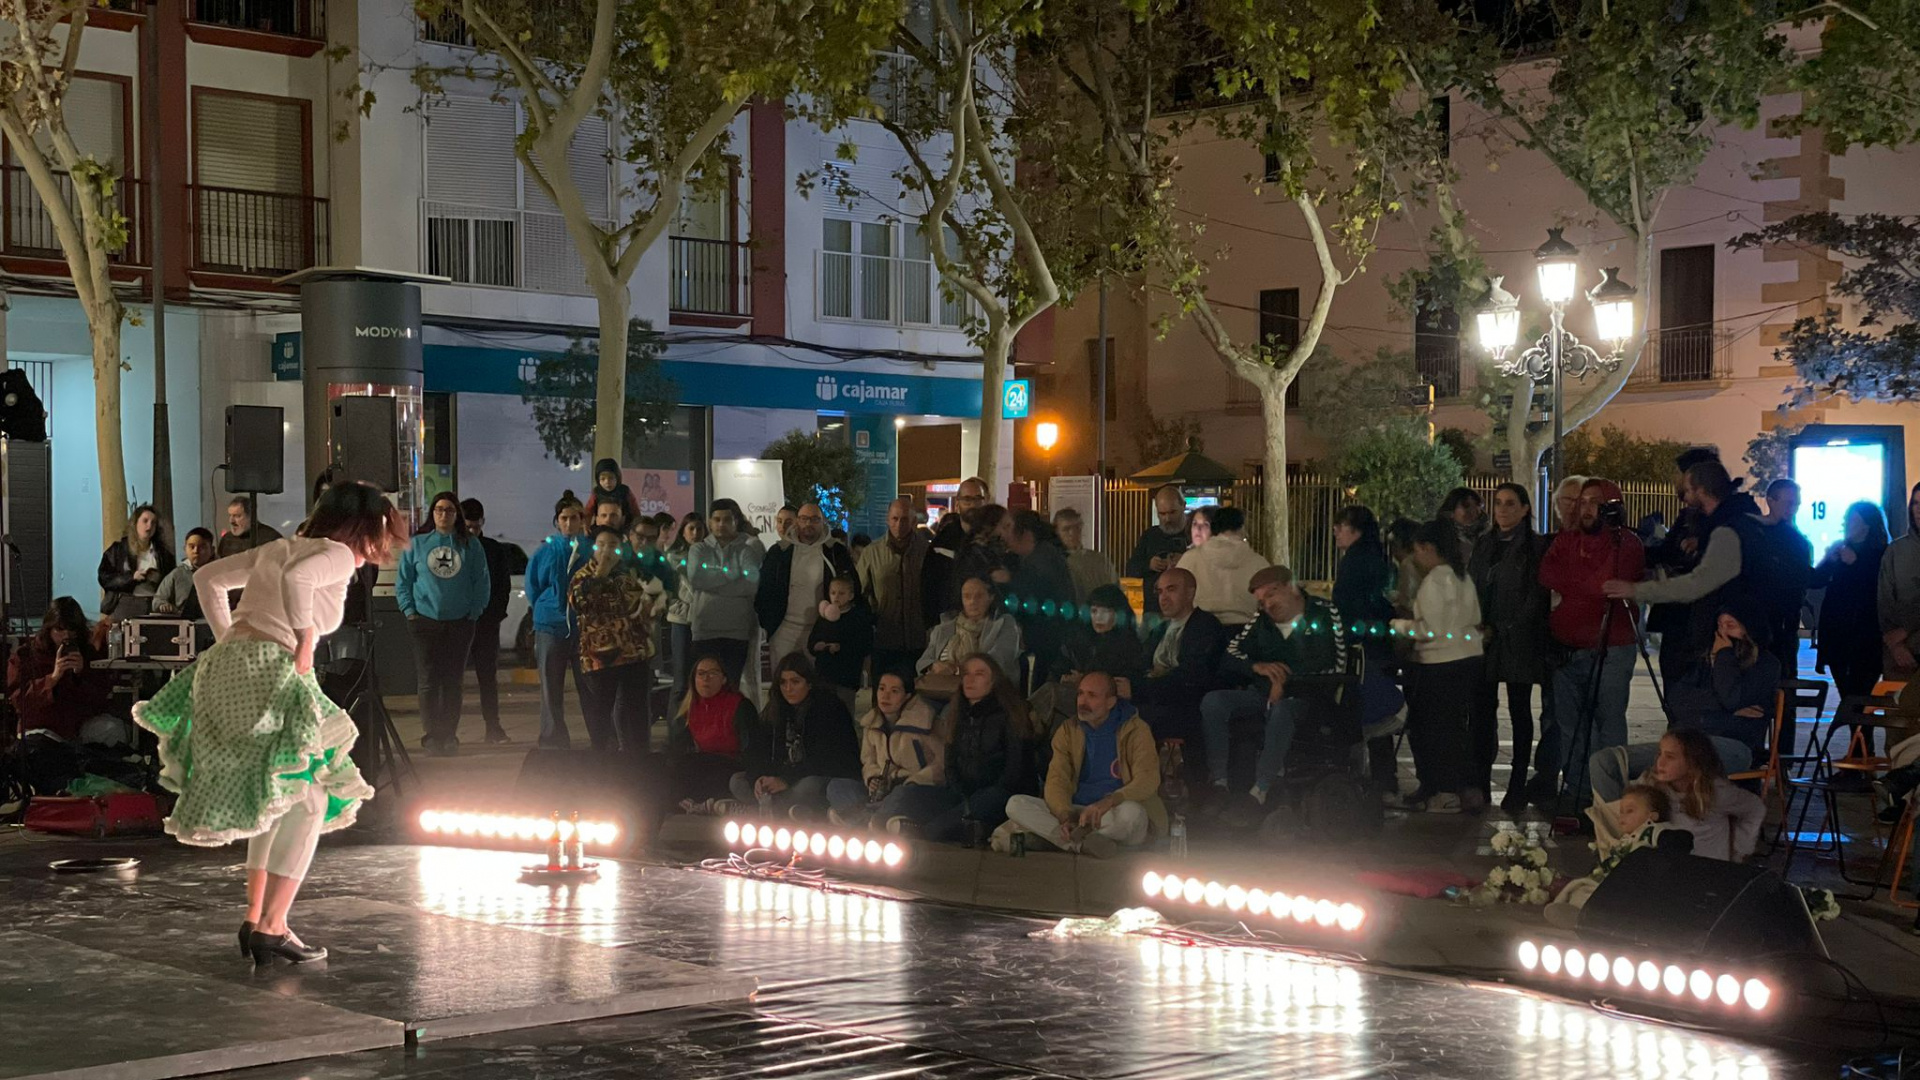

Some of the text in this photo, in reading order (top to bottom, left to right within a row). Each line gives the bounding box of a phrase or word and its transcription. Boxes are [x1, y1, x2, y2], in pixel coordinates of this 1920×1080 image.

[842, 380, 908, 403] cajamar
[1010, 391, 1023, 406] 24
[640, 500, 671, 512] 30%
[1811, 501, 1826, 520] 19
